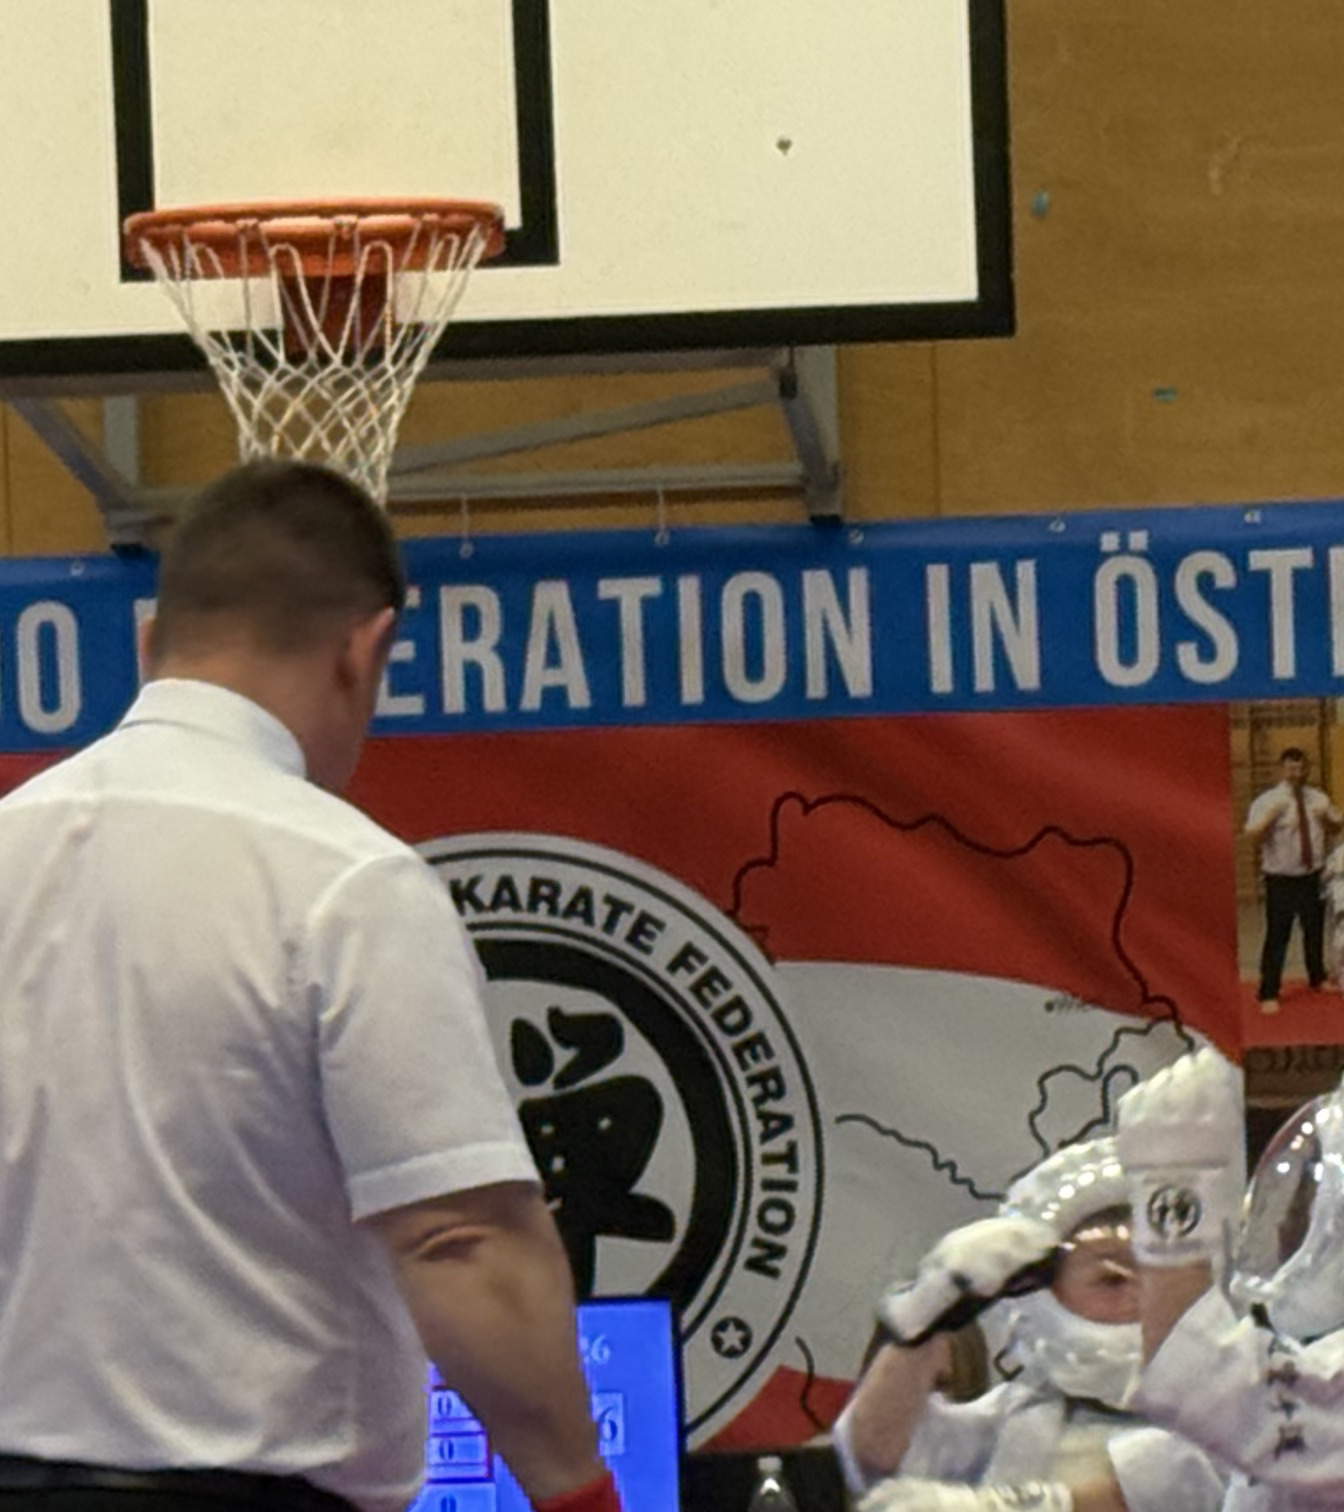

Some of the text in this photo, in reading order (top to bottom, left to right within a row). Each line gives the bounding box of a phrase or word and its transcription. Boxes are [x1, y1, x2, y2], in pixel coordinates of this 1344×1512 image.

[133, 566, 873, 717] ERATION
[925, 559, 1042, 695] IN
[449, 874, 666, 957] KARATE
[666, 940, 799, 1281] FEDERATION
[437, 1396, 453, 1418] 0
[438, 1439, 455, 1461] 0
